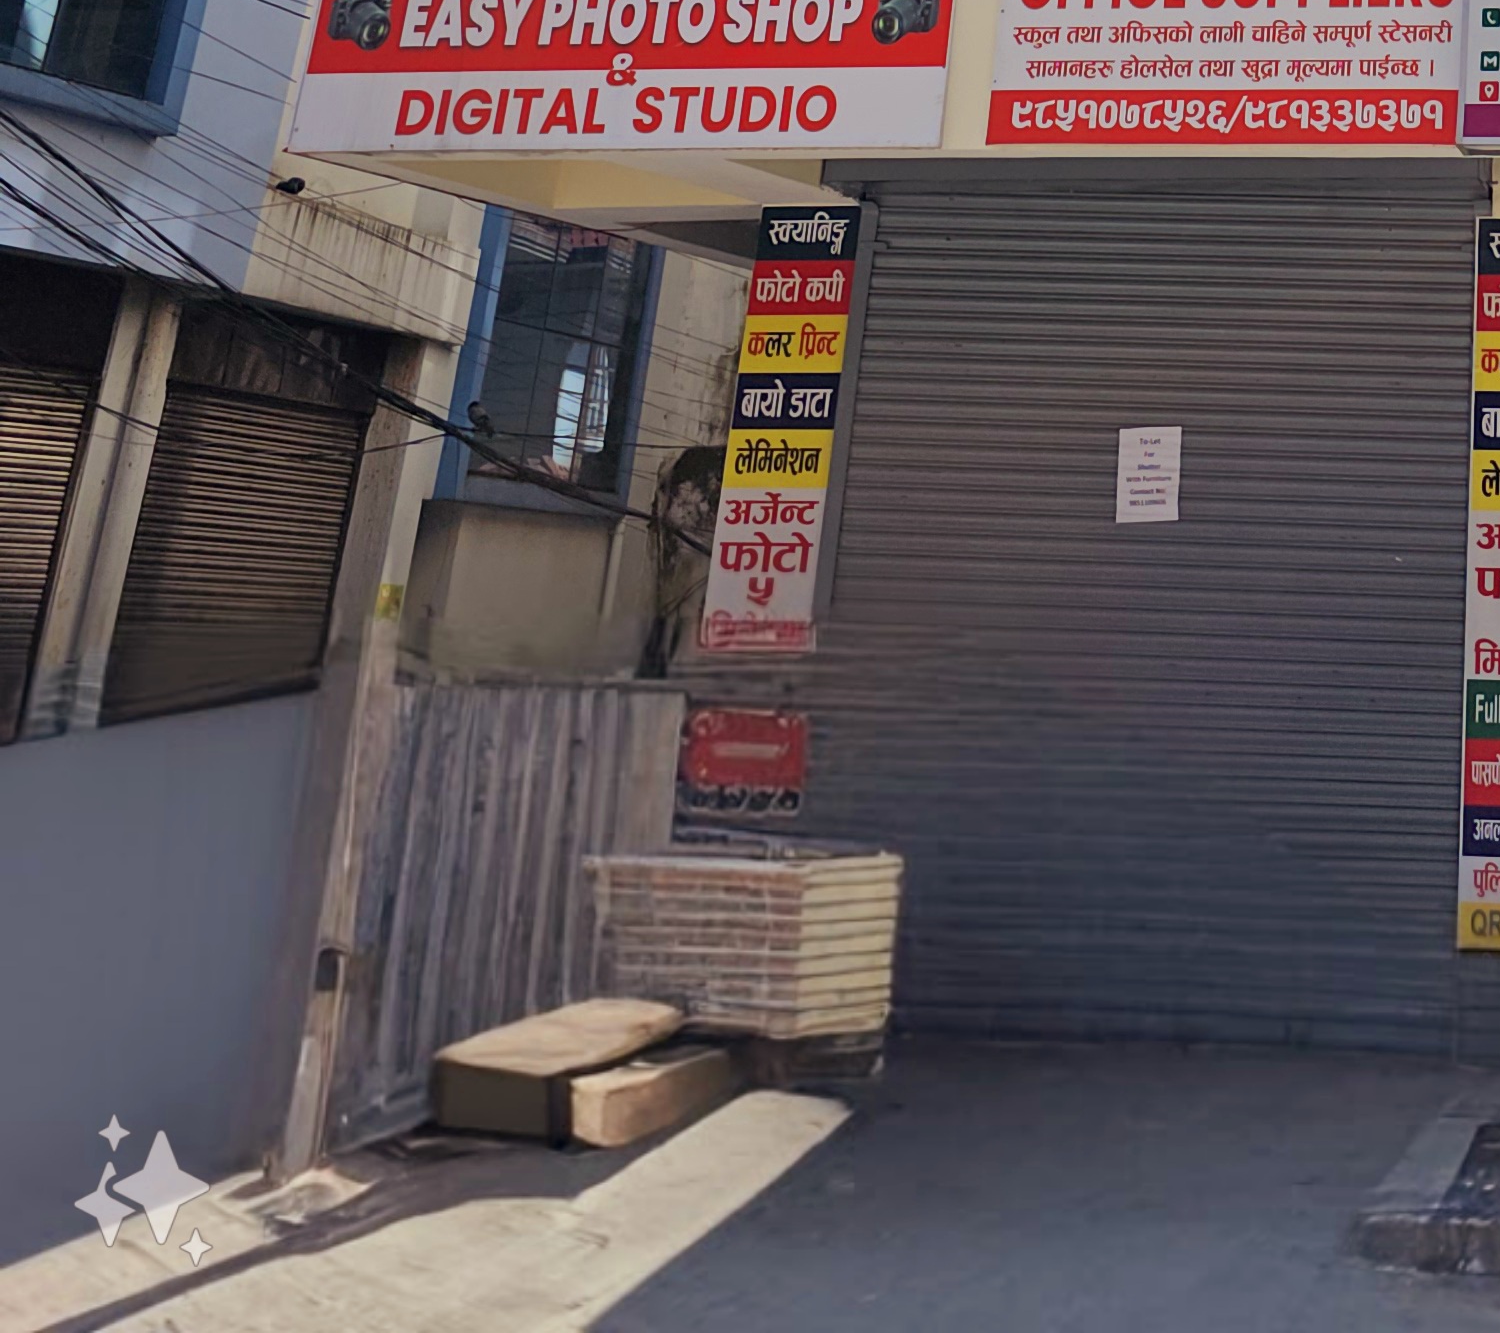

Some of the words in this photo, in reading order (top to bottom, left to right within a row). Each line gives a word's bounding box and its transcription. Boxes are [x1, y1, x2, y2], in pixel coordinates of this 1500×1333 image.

[1012, 26, 1062, 48] स्कुल
[1066, 26, 1102, 44] तथा
[1108, 20, 1194, 44] अफिसको
[1199, 20, 1246, 44] लागी
[1251, 20, 1307, 44] चाहिने
[1312, 20, 1372, 48] सम्पूर्ण
[1377, 19, 1453, 44] स्टेसनरी
[606, 53, 637, 87] &
[1119, 54, 1193, 79] होलसेल
[1198, 60, 1236, 78] तथा
[1241, 59, 1281, 82] खुद्रा
[1286, 59, 1353, 82] मूल्यमा
[1359, 54, 1421, 79] पाईन्छ
[394, 88, 606, 136] DIGITAL
[633, 85, 838, 134] STUDIO
[755, 270, 802, 303] फोटो
[805, 268, 846, 303] कपी
[747, 331, 796, 357] कलर
[798, 322, 841, 360] प्रिन्ट
[741, 379, 786, 418] बायो
[789, 388, 834, 419] डाटा
[734, 438, 822, 476] लेमिनेशन
[723, 492, 820, 525] अर्जेन्ट
[719, 532, 814, 574] फोटो
[747, 577, 775, 606] ५
